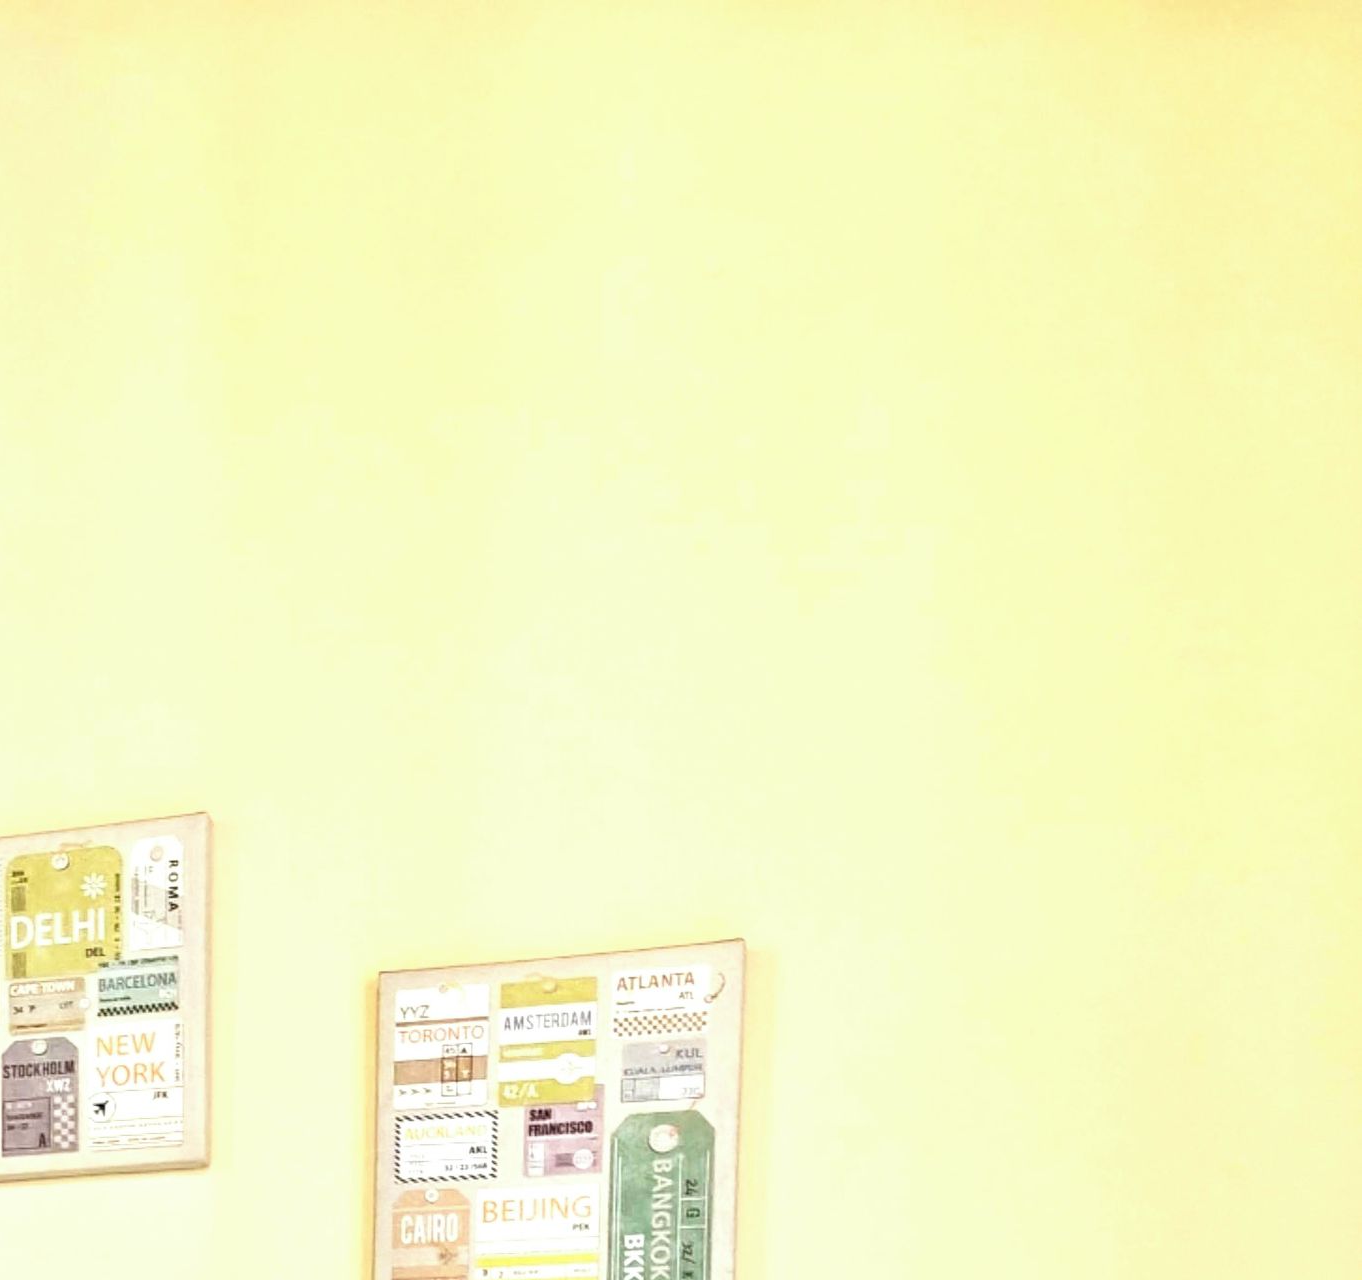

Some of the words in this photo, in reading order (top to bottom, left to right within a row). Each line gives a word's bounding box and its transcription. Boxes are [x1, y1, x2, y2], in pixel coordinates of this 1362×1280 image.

[168, 859, 179, 912] ROMA
[10, 907, 106, 950] DELHI
[98, 972, 177, 992] BARCELONA
[617, 972, 695, 991] ATLANTA
[400, 1005, 430, 1019] YYZ
[504, 1011, 592, 1031] AMSTERDAM
[398, 1025, 485, 1043] TORONTO
[96, 1032, 156, 1057] NEW
[3, 1060, 75, 1079] STOCKHOLM
[96, 1061, 166, 1087] YORK
[530, 1109, 552, 1122] SAN
[528, 1120, 593, 1137] FRANCISCO
[482, 1195, 591, 1223] BEIJING
[401, 1213, 458, 1245] CAIRO
[650, 1159, 672, 1280] BANGKOK
